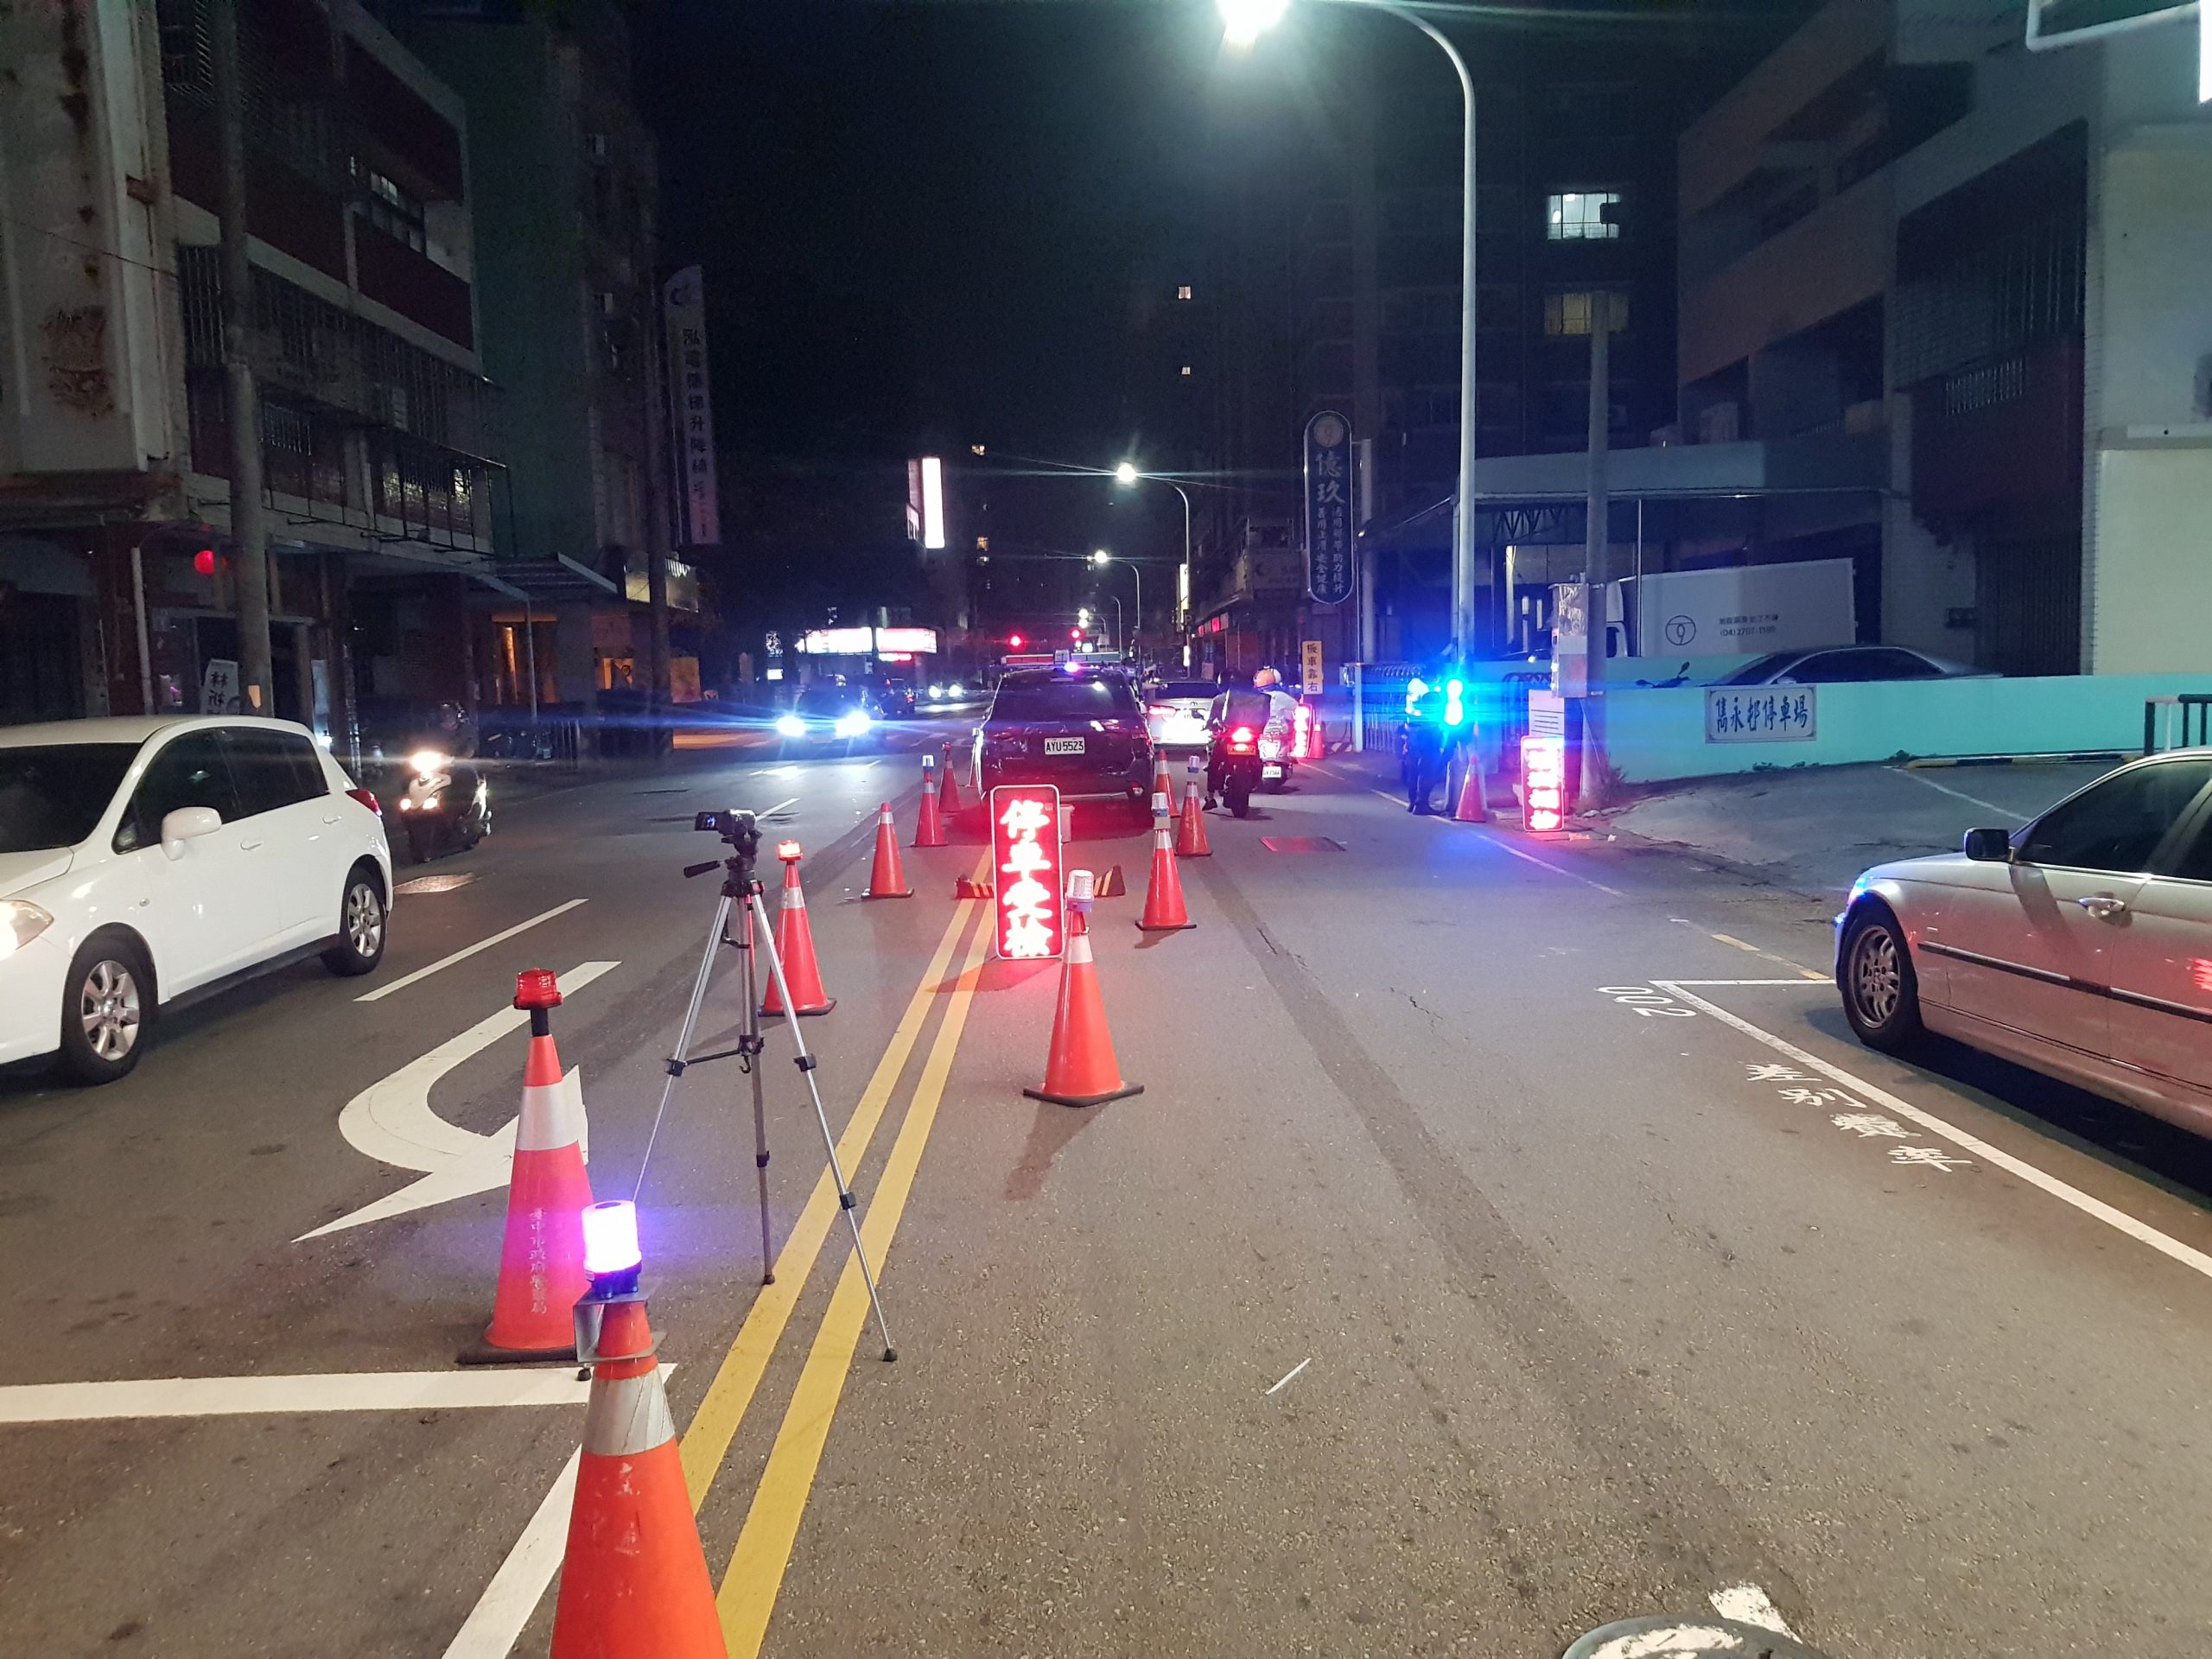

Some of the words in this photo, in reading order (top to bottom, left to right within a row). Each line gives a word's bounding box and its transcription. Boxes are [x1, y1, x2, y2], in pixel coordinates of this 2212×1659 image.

[1314, 449, 1346, 505] 億玖
[999, 799, 1054, 957] 停車受檢
